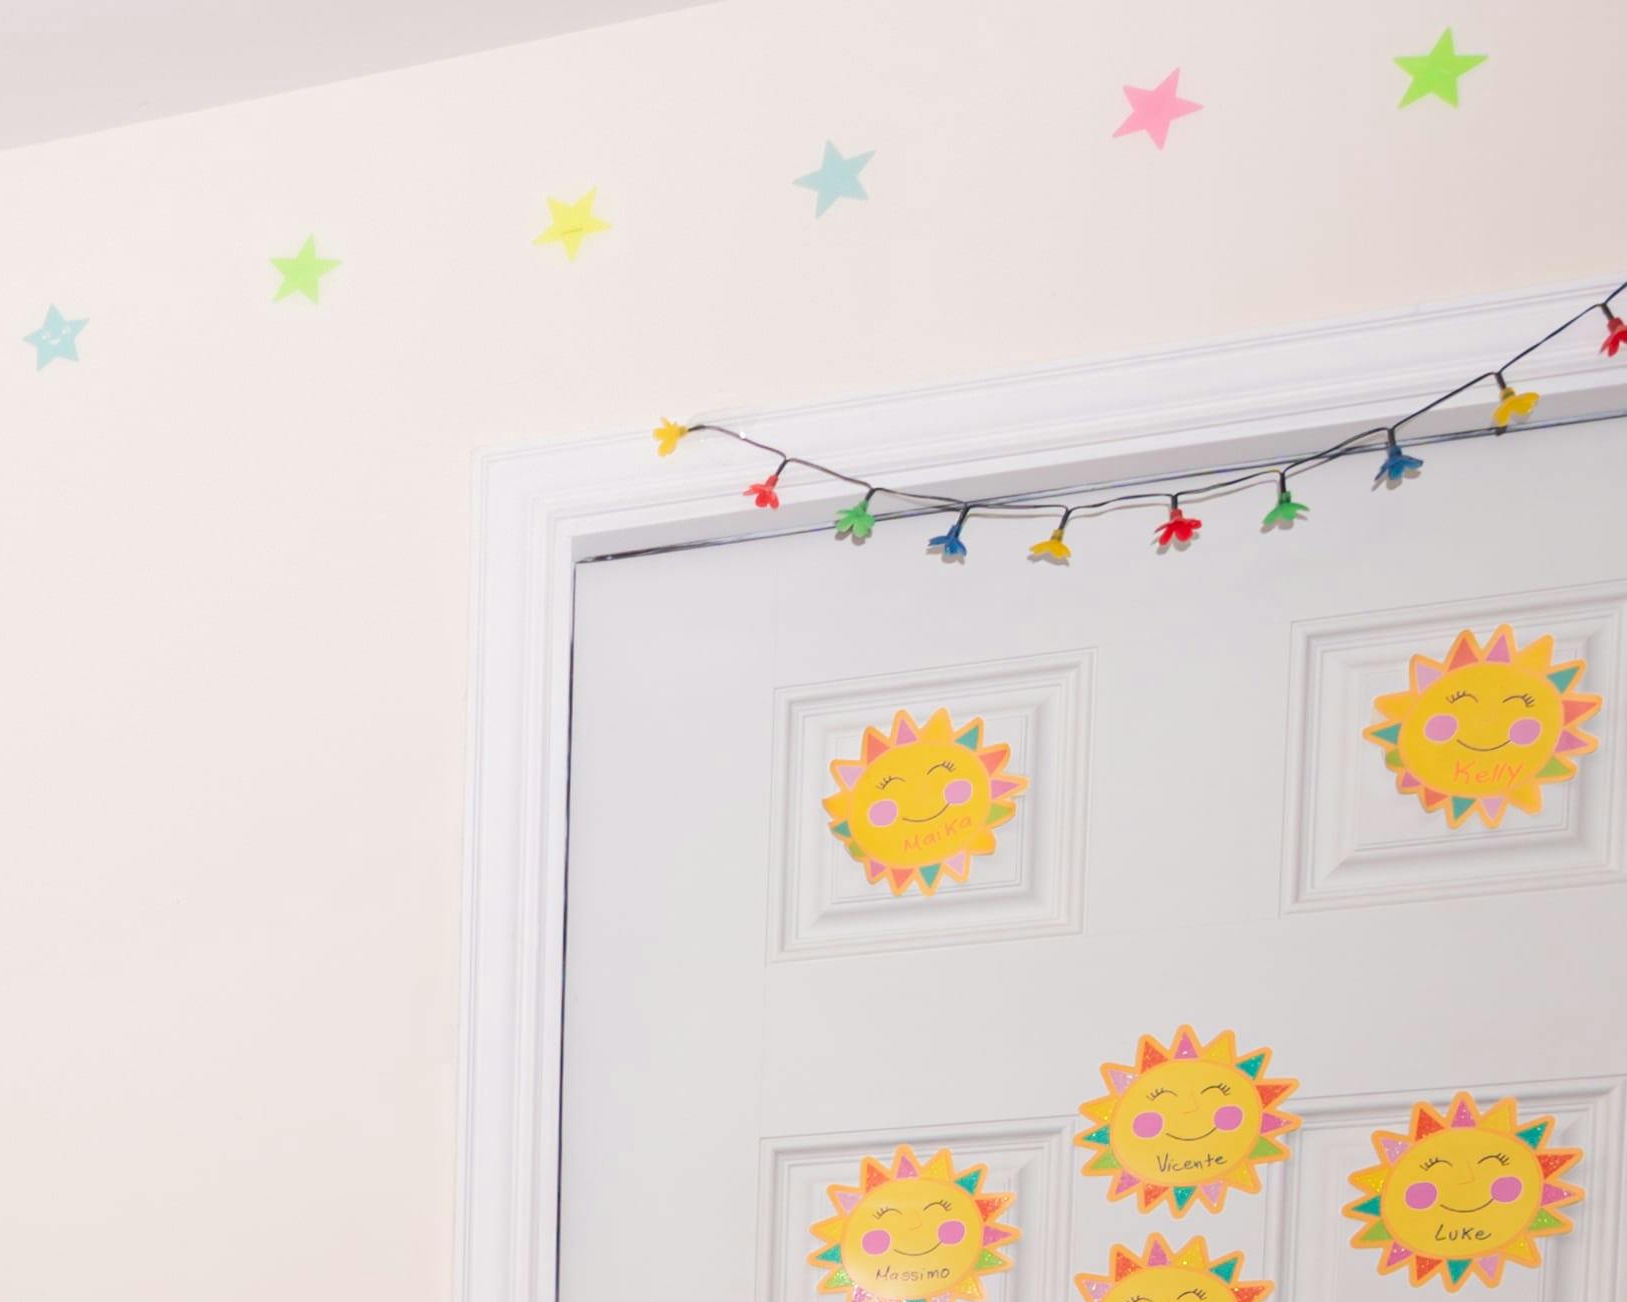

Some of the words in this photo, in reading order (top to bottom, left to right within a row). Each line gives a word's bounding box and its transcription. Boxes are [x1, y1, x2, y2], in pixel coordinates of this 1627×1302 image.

[1453, 760, 1523, 787] Kelly
[1156, 1153, 1228, 1174] Vicente
[875, 1265, 951, 1282] Massimo
